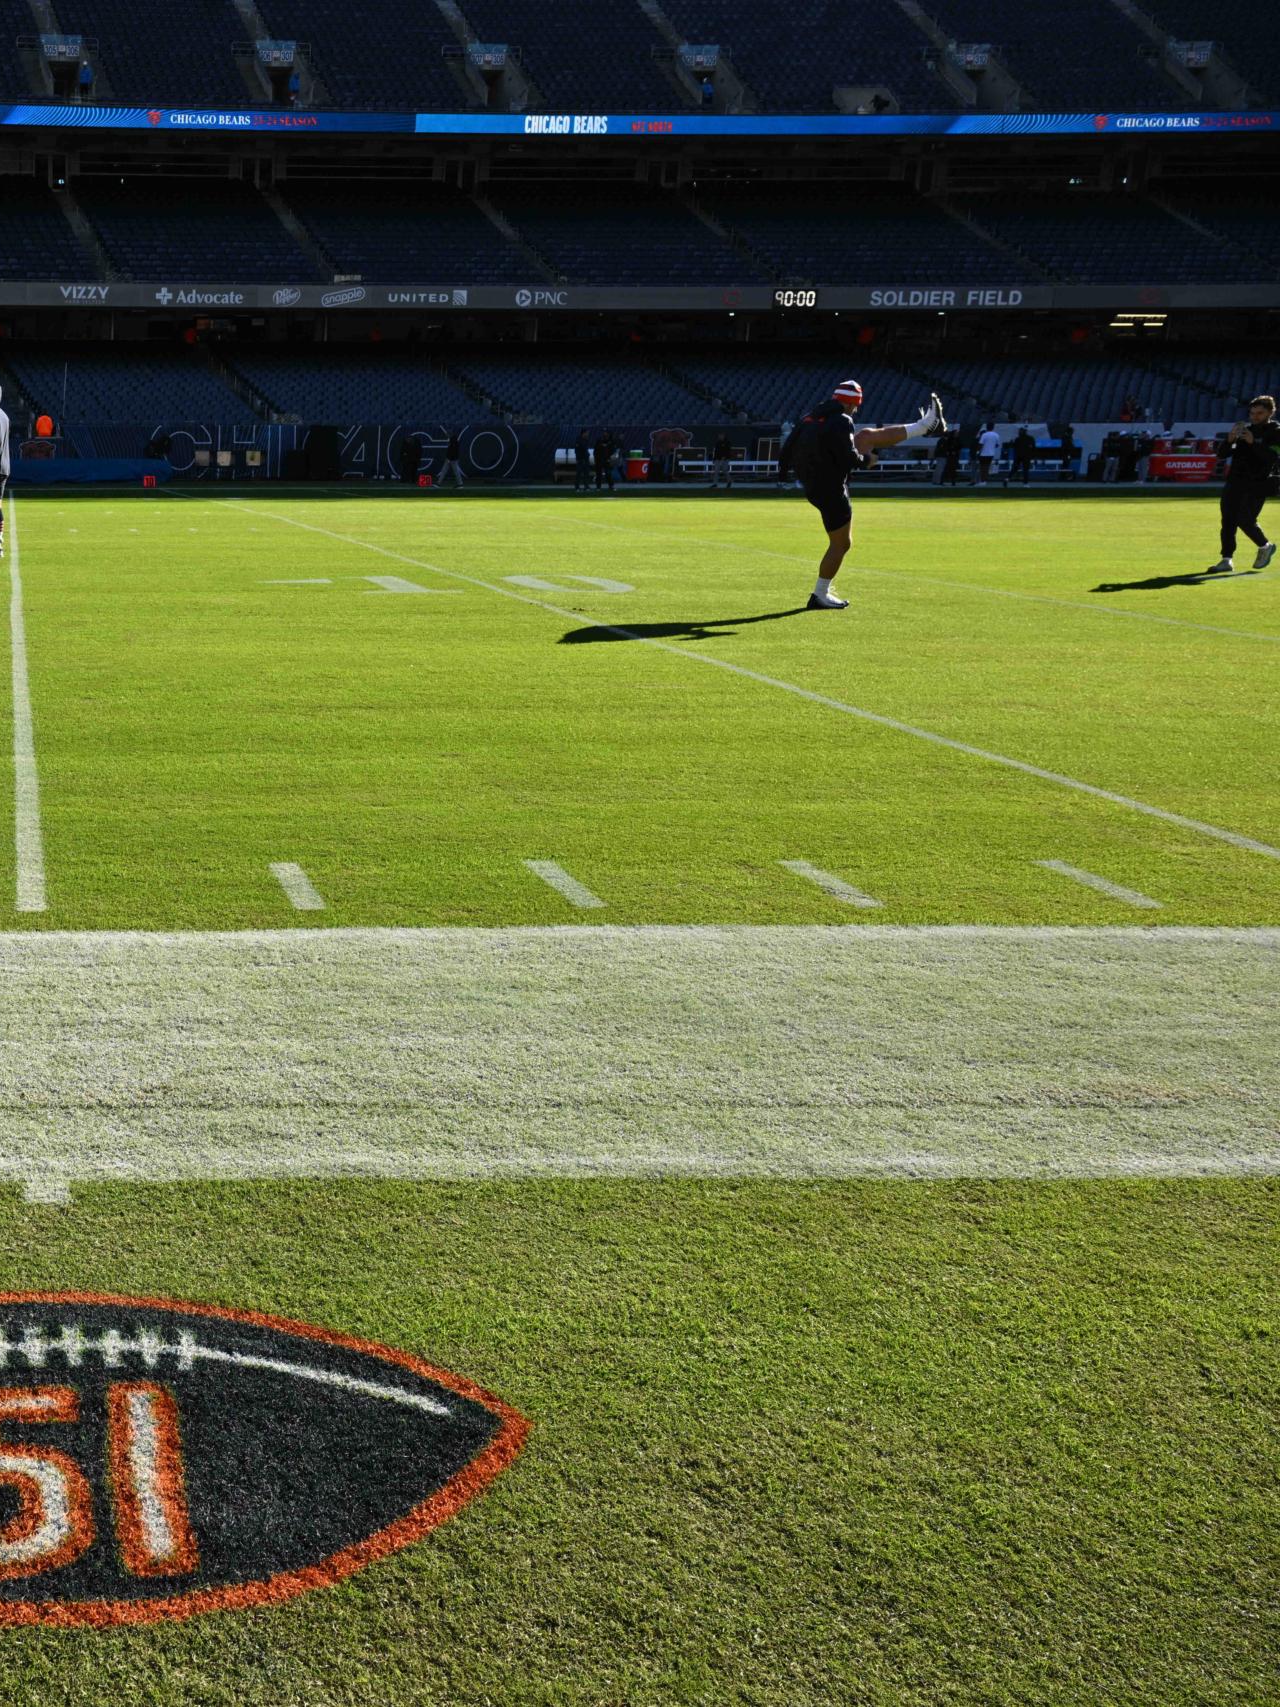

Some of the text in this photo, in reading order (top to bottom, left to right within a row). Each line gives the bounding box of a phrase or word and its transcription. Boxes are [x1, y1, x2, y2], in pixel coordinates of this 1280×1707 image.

[170, 114, 217, 124] CHICAGO
[219, 115, 250, 125] BEARS
[279, 116, 317, 125] SEASON
[524, 115, 608, 133] CHICAGO BEARS
[1116, 117, 1164, 128] CHICAGO
[1166, 117, 1200, 127] BEARS
[60, 286, 109, 299] VIZZY
[176, 289, 244, 304] Advocate
[388, 292, 449, 303] UNITED
[534, 291, 568, 305] PNC
[775, 290, 816, 307] 90:00
[870, 290, 1023, 306] SOLDIER FIELD
[641, 462, 649, 474] G
[1165, 461, 1208, 469] GATORADE
